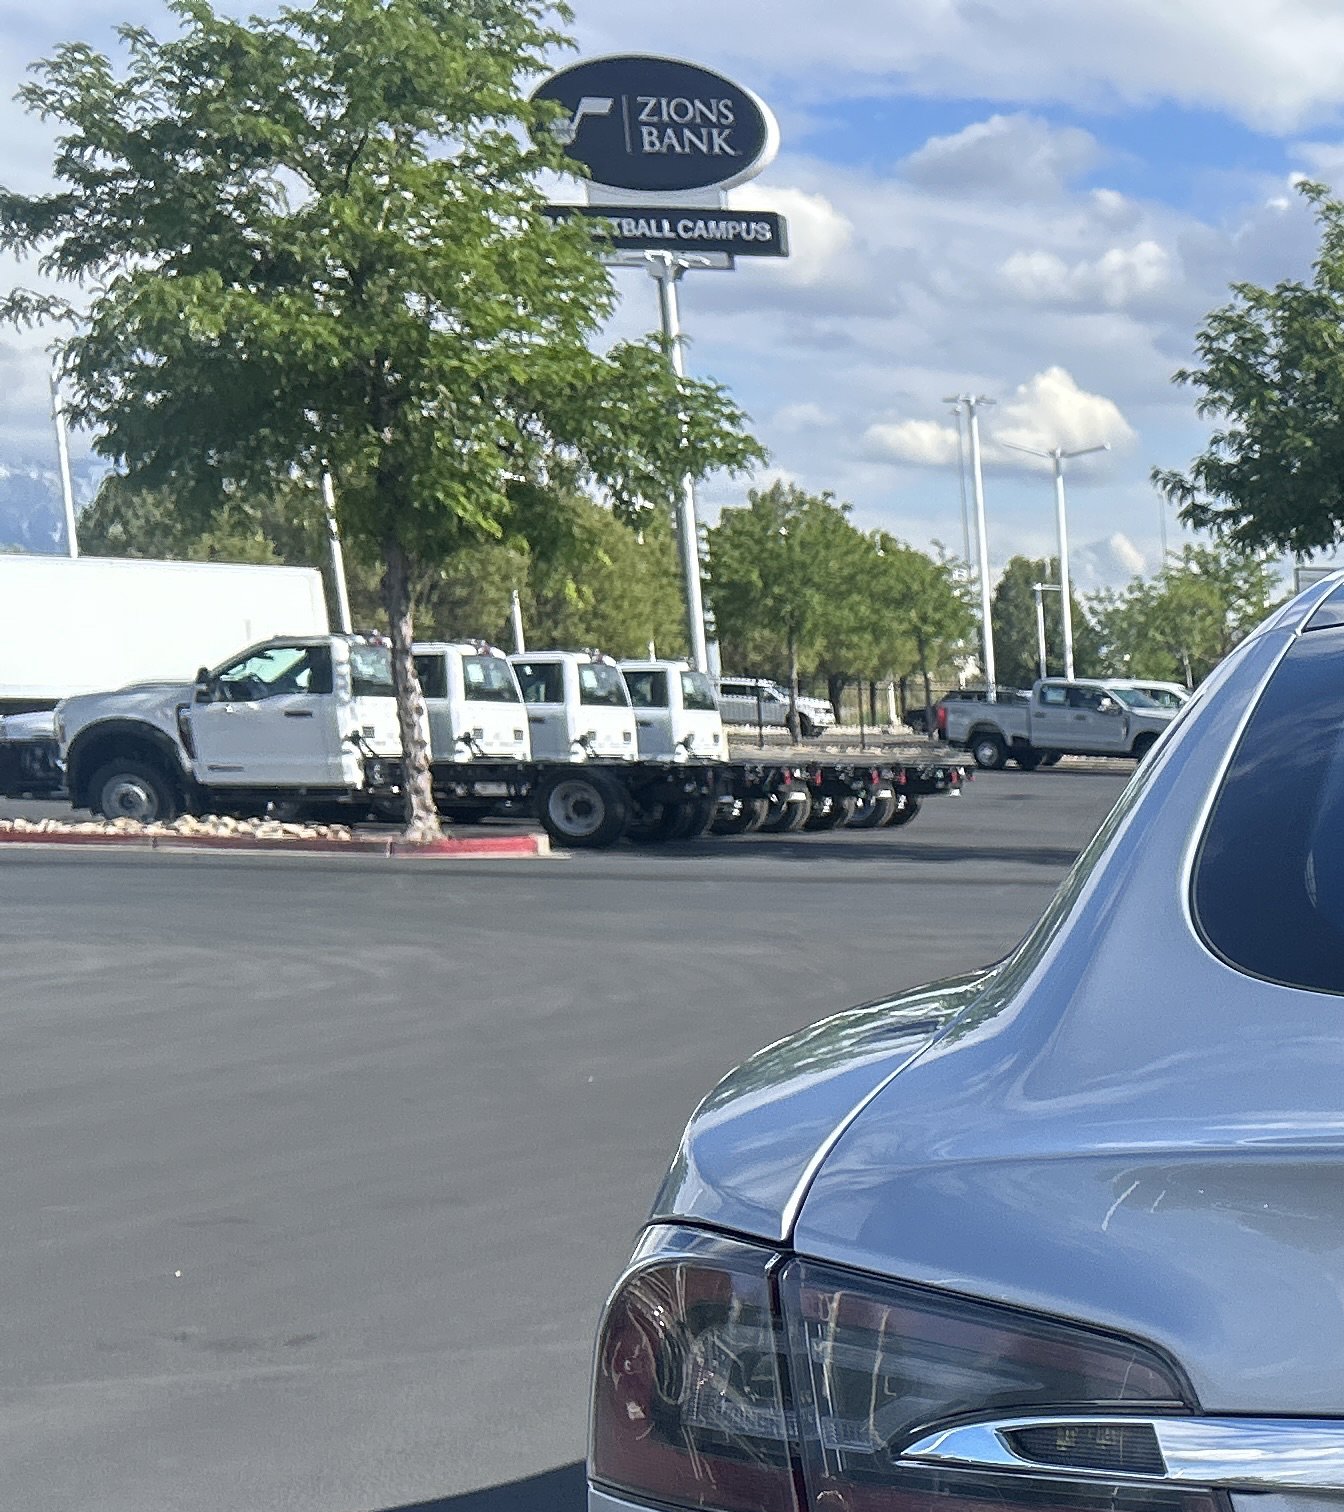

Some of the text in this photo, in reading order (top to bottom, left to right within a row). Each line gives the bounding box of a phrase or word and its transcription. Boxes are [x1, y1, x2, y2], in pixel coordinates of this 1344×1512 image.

[636, 96, 736, 125] ZIONS
[640, 125, 740, 156] BANK
[677, 217, 773, 241] CAMPUS
